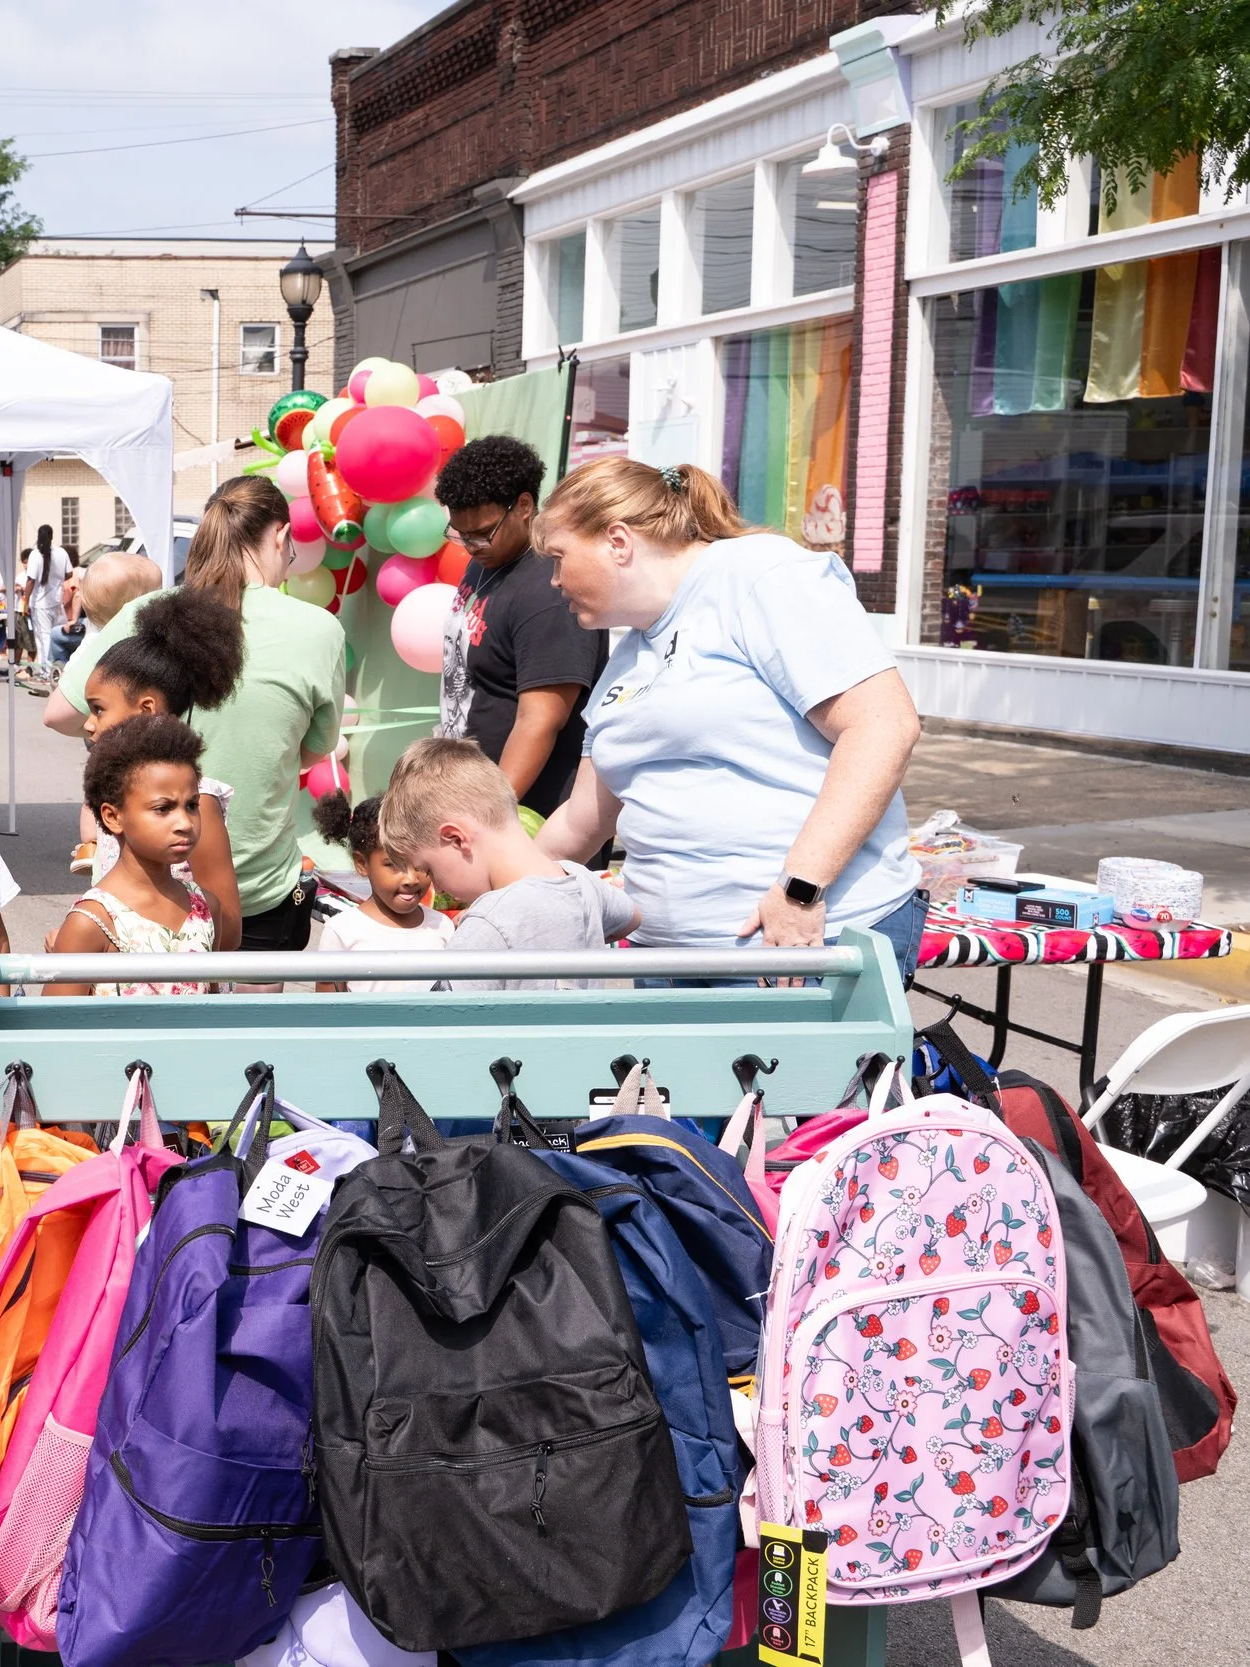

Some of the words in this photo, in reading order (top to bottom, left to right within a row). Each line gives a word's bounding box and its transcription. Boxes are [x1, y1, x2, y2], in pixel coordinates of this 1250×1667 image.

[1055, 908, 1070, 916] 500
[256, 1174, 292, 1213] Moda
[276, 1183, 310, 1219] West
[805, 1557, 819, 1627] BACKPACK
